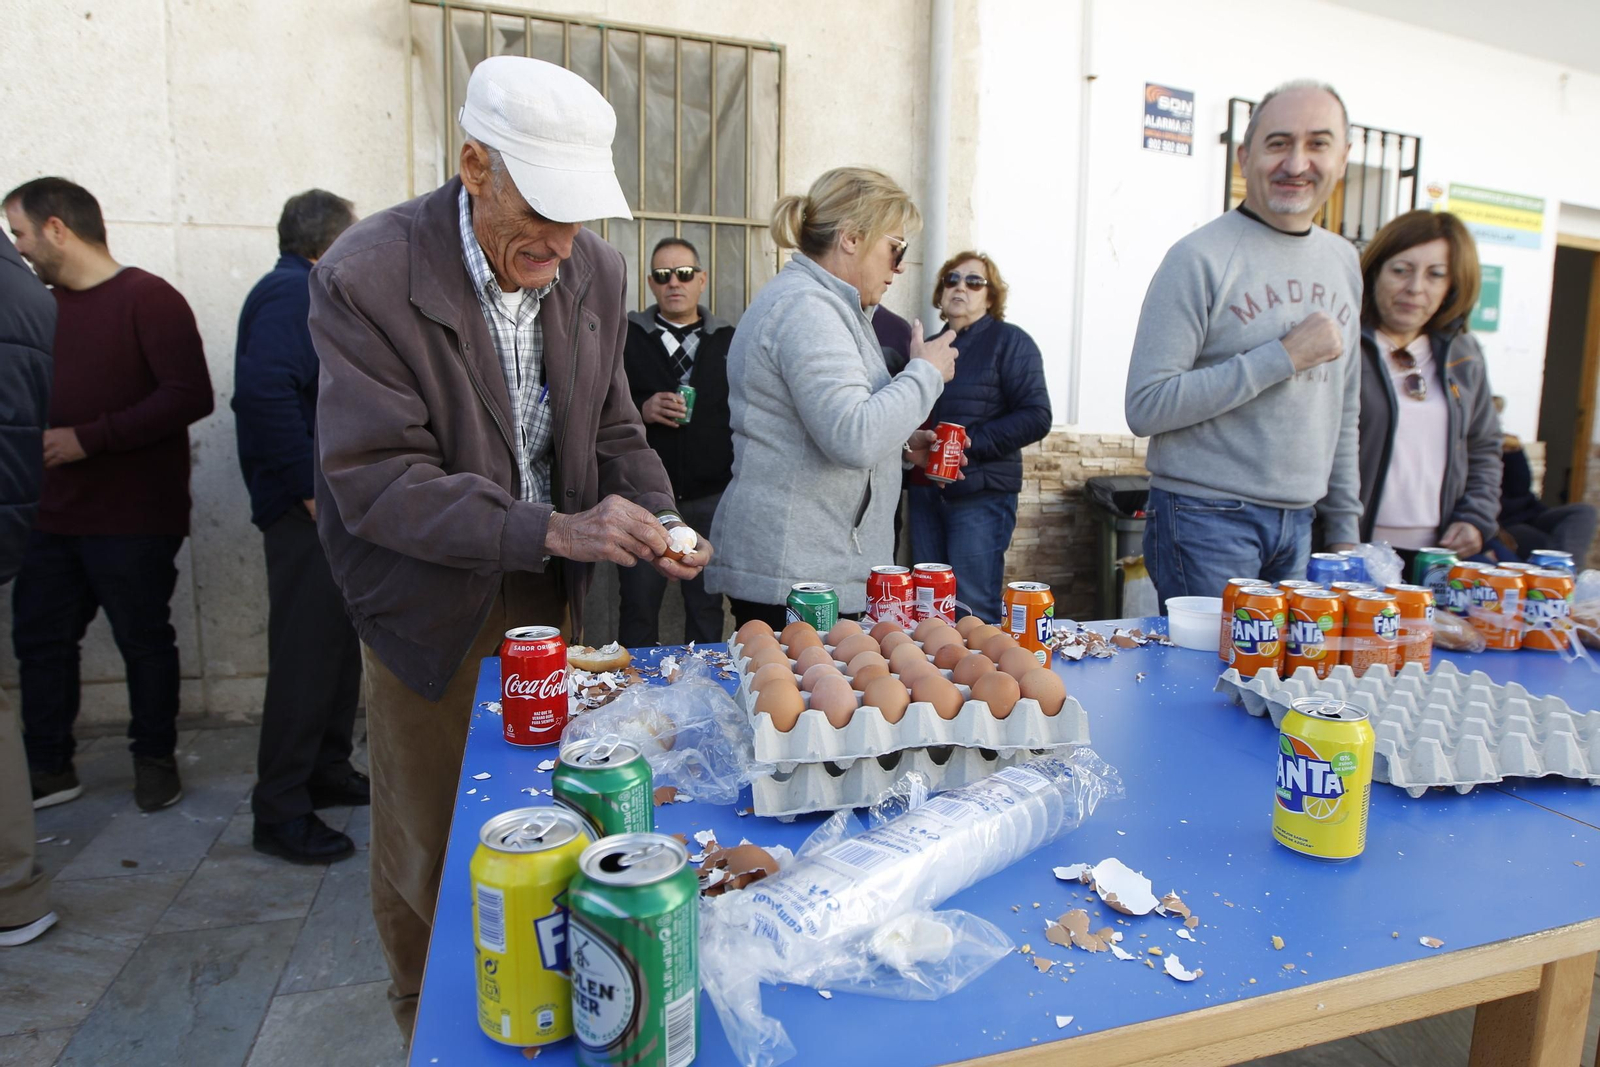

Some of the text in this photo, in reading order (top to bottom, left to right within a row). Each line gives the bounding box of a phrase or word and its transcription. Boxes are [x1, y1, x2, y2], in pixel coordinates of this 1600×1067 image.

[1157, 95, 1193, 113] SDN
[1145, 114, 1183, 132] ALARMA
[1228, 279, 1351, 326] MADRID
[1290, 621, 1325, 643] NTA
[513, 641, 562, 652] SABOR ORIGINAL
[504, 668, 566, 700] Coca-Cola
[1276, 752, 1343, 795] ANTA
[752, 892, 802, 935] campisol
